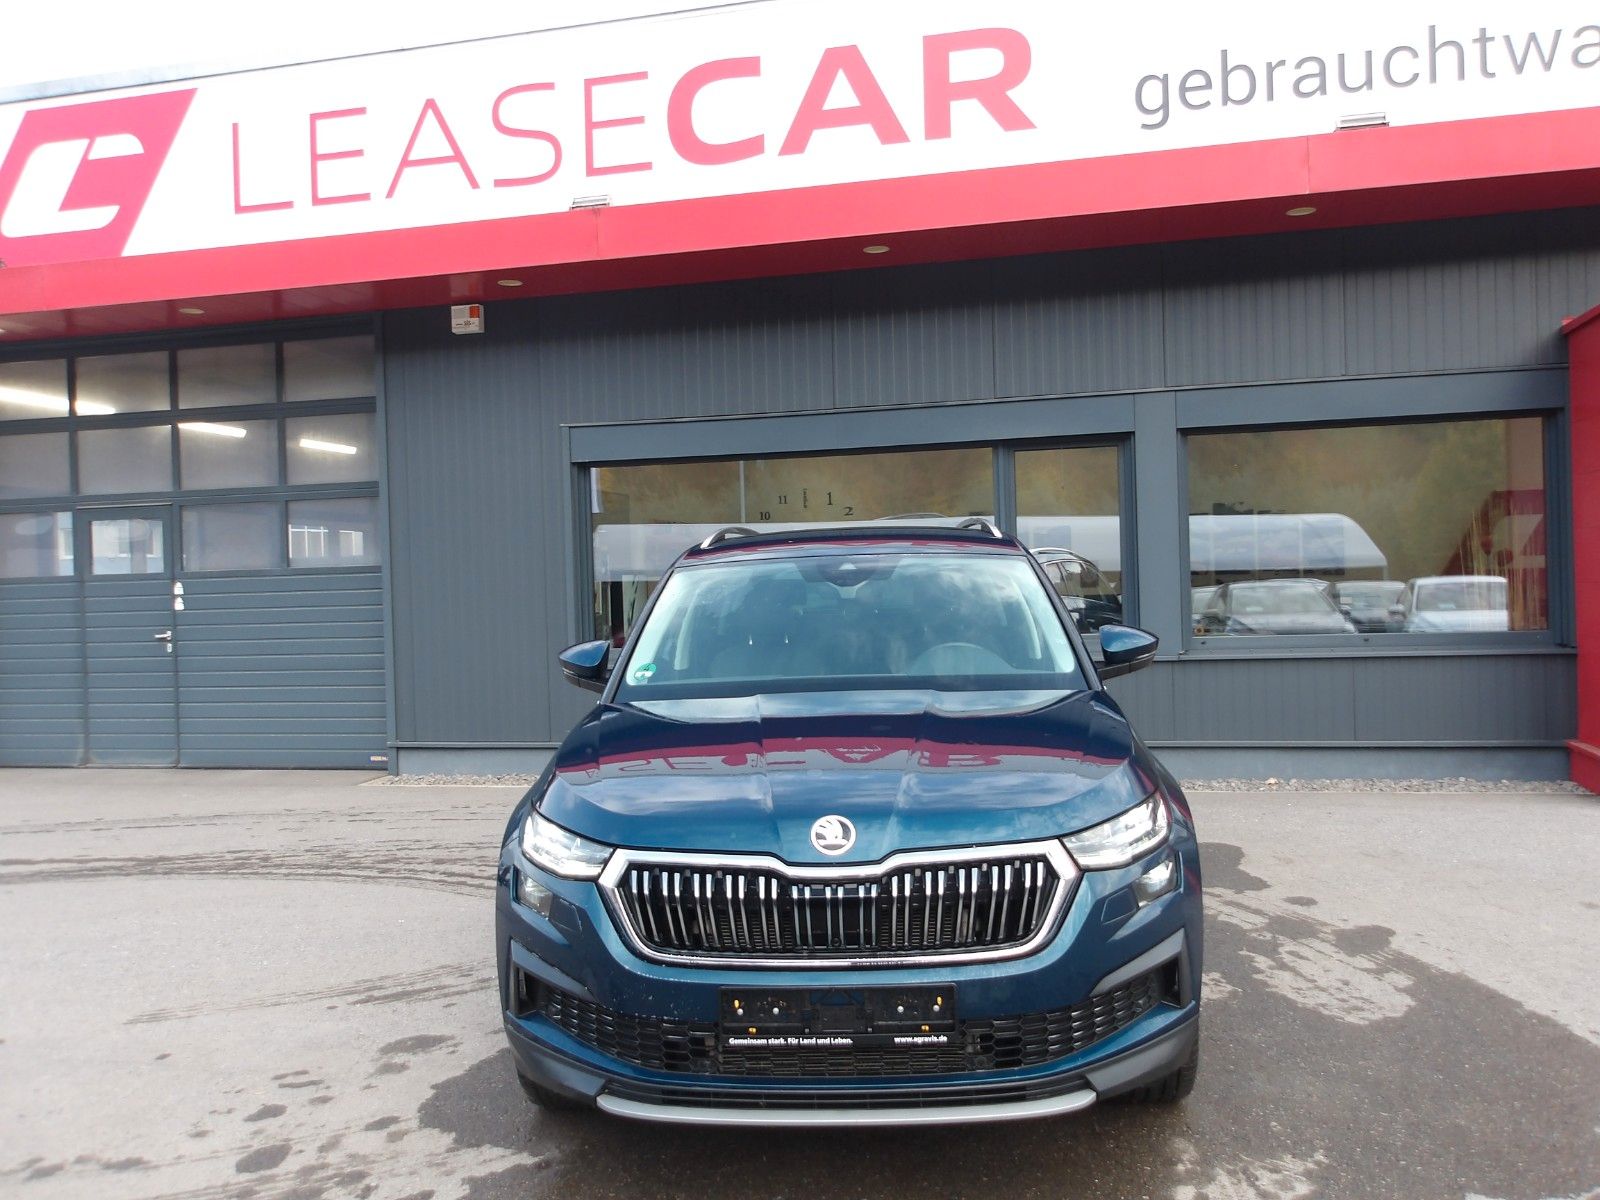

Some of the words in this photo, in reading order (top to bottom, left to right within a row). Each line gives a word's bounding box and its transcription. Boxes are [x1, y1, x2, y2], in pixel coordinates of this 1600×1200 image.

[232, 28, 1034, 214] LEASECAR
[778, 495, 788, 504] 11
[826, 491, 833, 505] 1
[760, 511, 770, 520] 10
[844, 506, 854, 516] 2
[729, 1036, 767, 1045] Gemeinsam
[768, 1036, 786, 1045] stark.
[787, 1036, 799, 1045] Für
[799, 1036, 816, 1045] Land
[817, 1036, 830, 1045] und
[831, 1036, 853, 1045] Leben.
[893, 1034, 948, 1045] www.agravis.de
